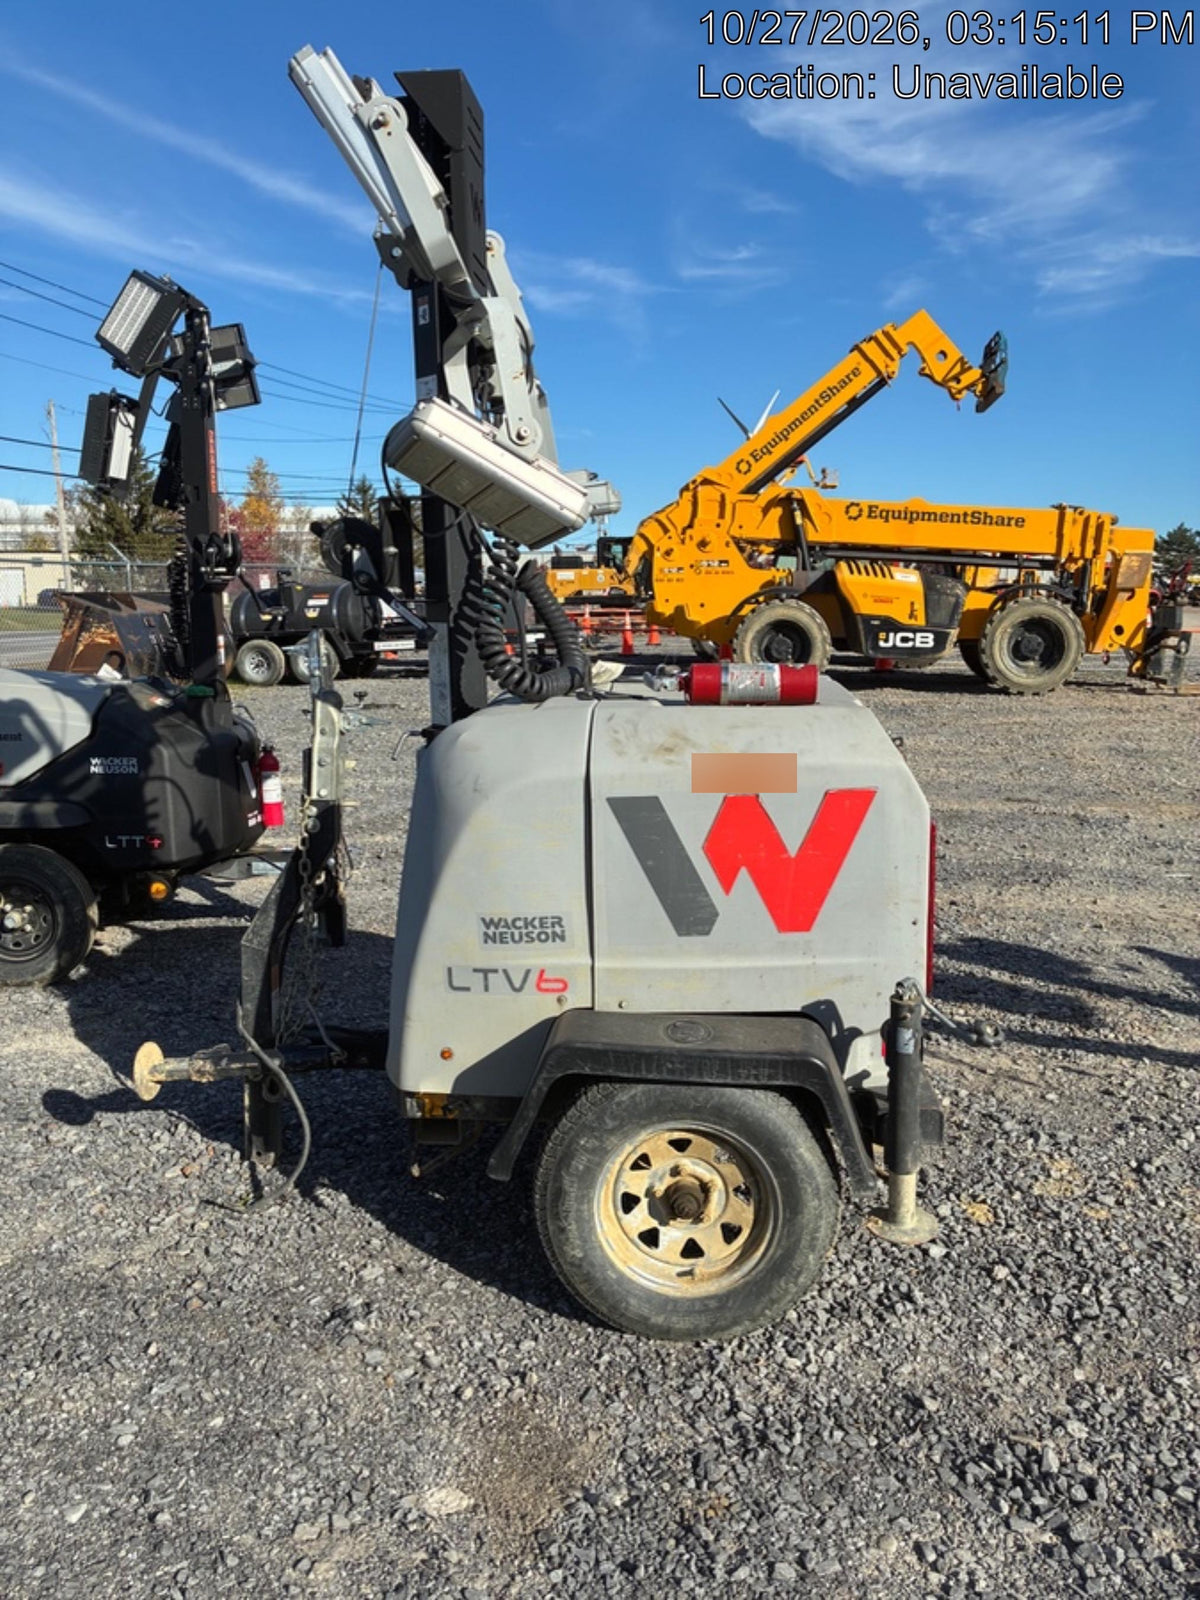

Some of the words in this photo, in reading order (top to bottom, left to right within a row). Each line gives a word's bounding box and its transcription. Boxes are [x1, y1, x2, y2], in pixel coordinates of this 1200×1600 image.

[749, 366, 862, 463] EquipmentShare
[866, 504, 1026, 528] EquipmentShare
[878, 632, 935, 648] JCB
[89, 756, 138, 765] WACKER
[89, 765, 139, 774] NEUSON
[480, 915, 565, 930] WACKER
[482, 929, 567, 944] NEUSON
[446, 966, 569, 993] LTV6
